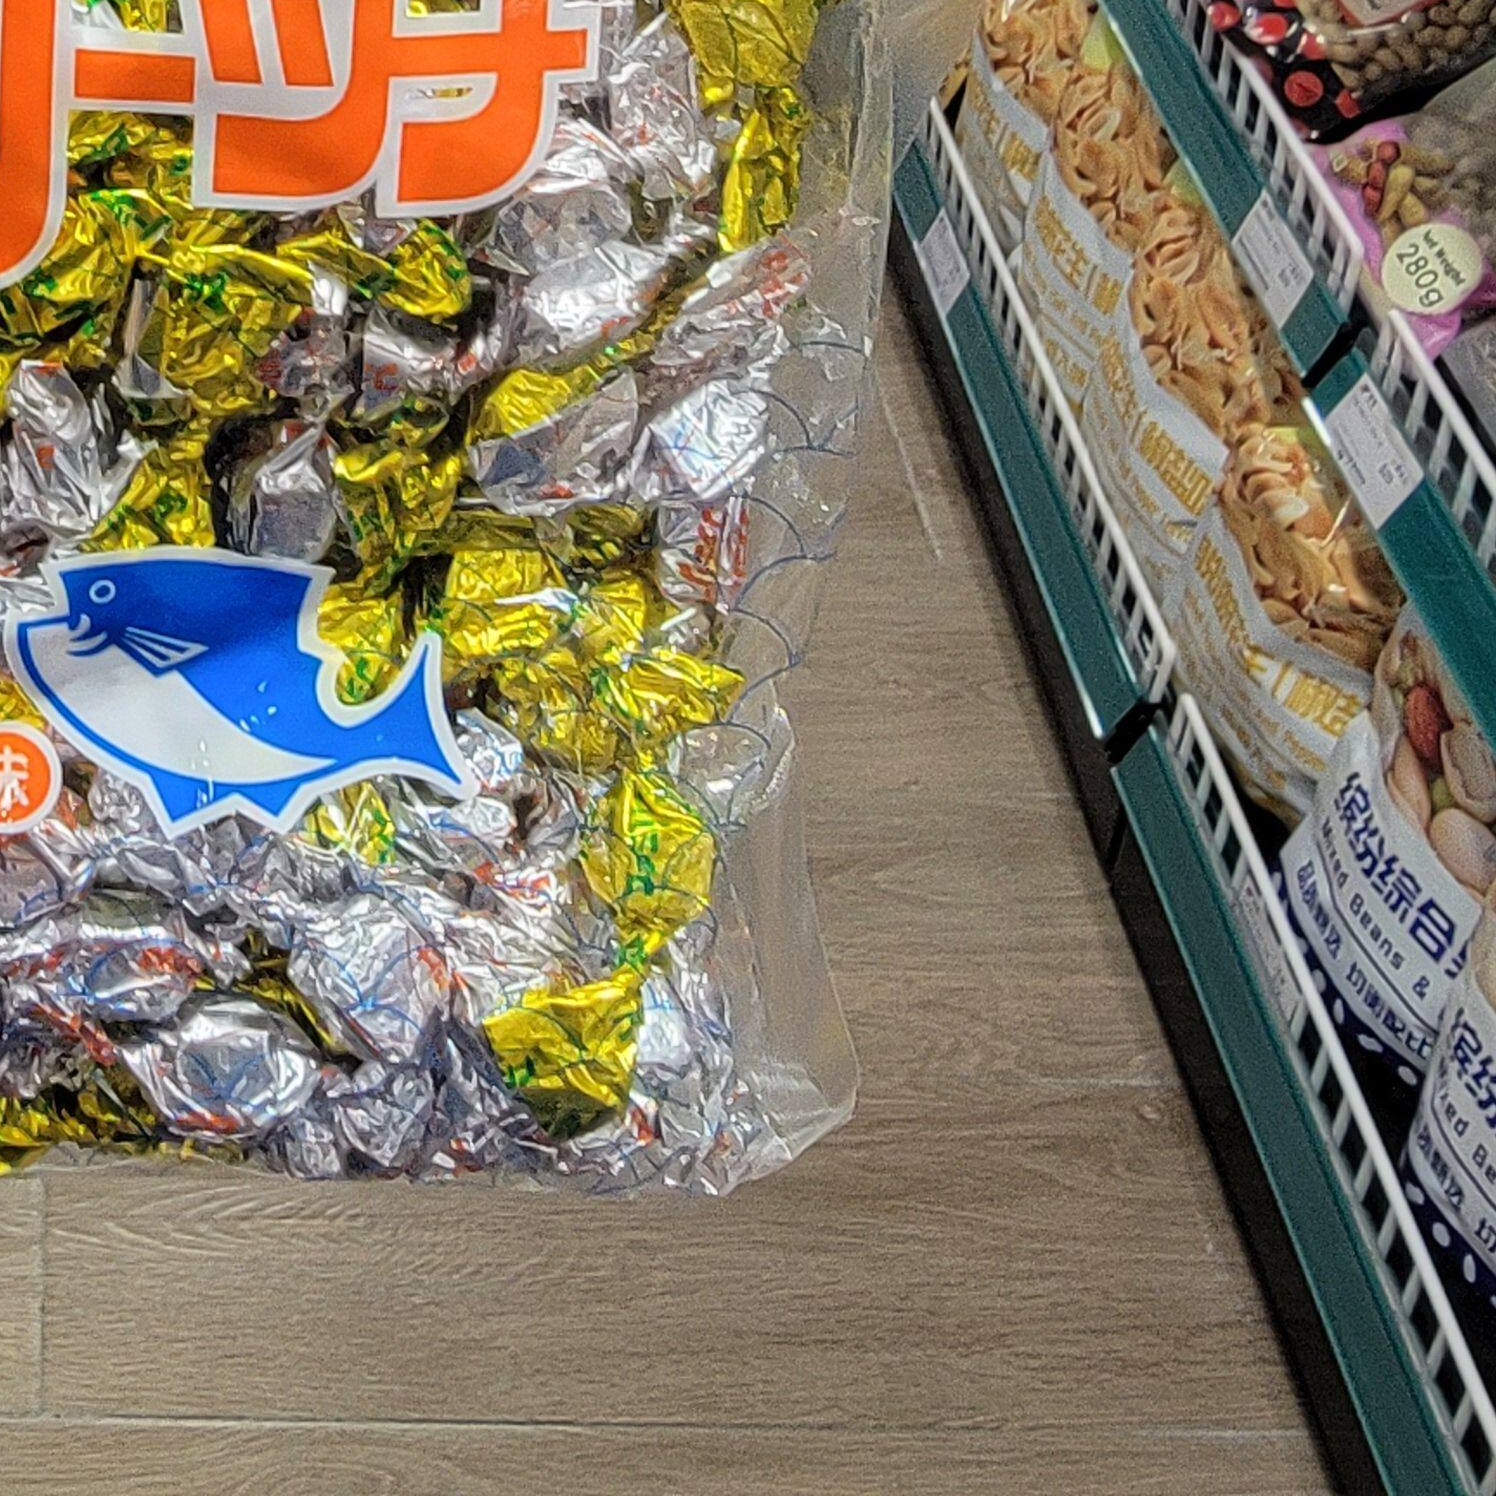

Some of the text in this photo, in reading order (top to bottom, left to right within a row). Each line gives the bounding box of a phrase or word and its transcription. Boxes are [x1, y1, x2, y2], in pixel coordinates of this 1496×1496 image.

[1396, 243, 1444, 308] 280g
[1349, 892, 1405, 971] Beans
[1412, 975, 1431, 999] &
